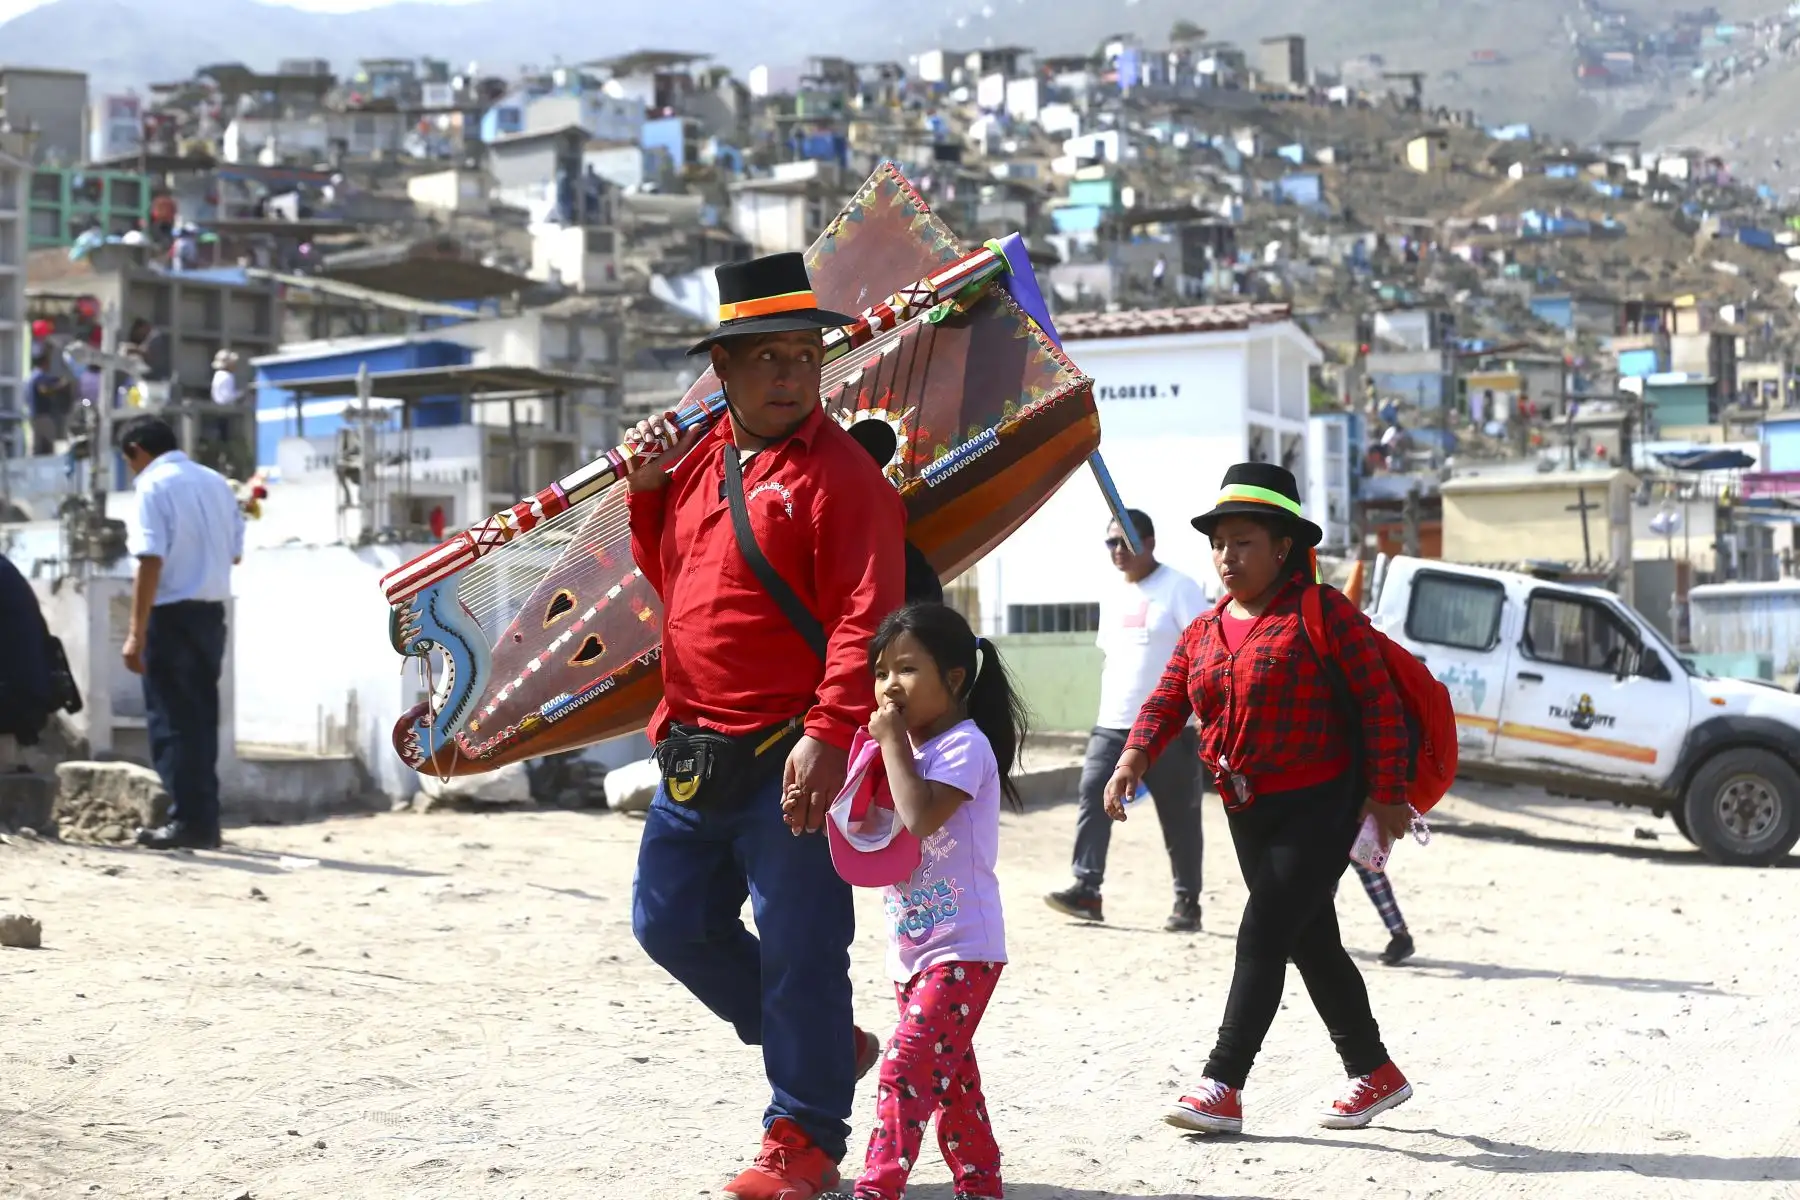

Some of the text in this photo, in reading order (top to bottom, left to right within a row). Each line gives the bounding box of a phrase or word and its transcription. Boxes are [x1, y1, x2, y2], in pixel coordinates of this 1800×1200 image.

[675, 758, 695, 773] CAT
[900, 877, 953, 909] LOVE
[894, 898, 959, 936] MUSIC
